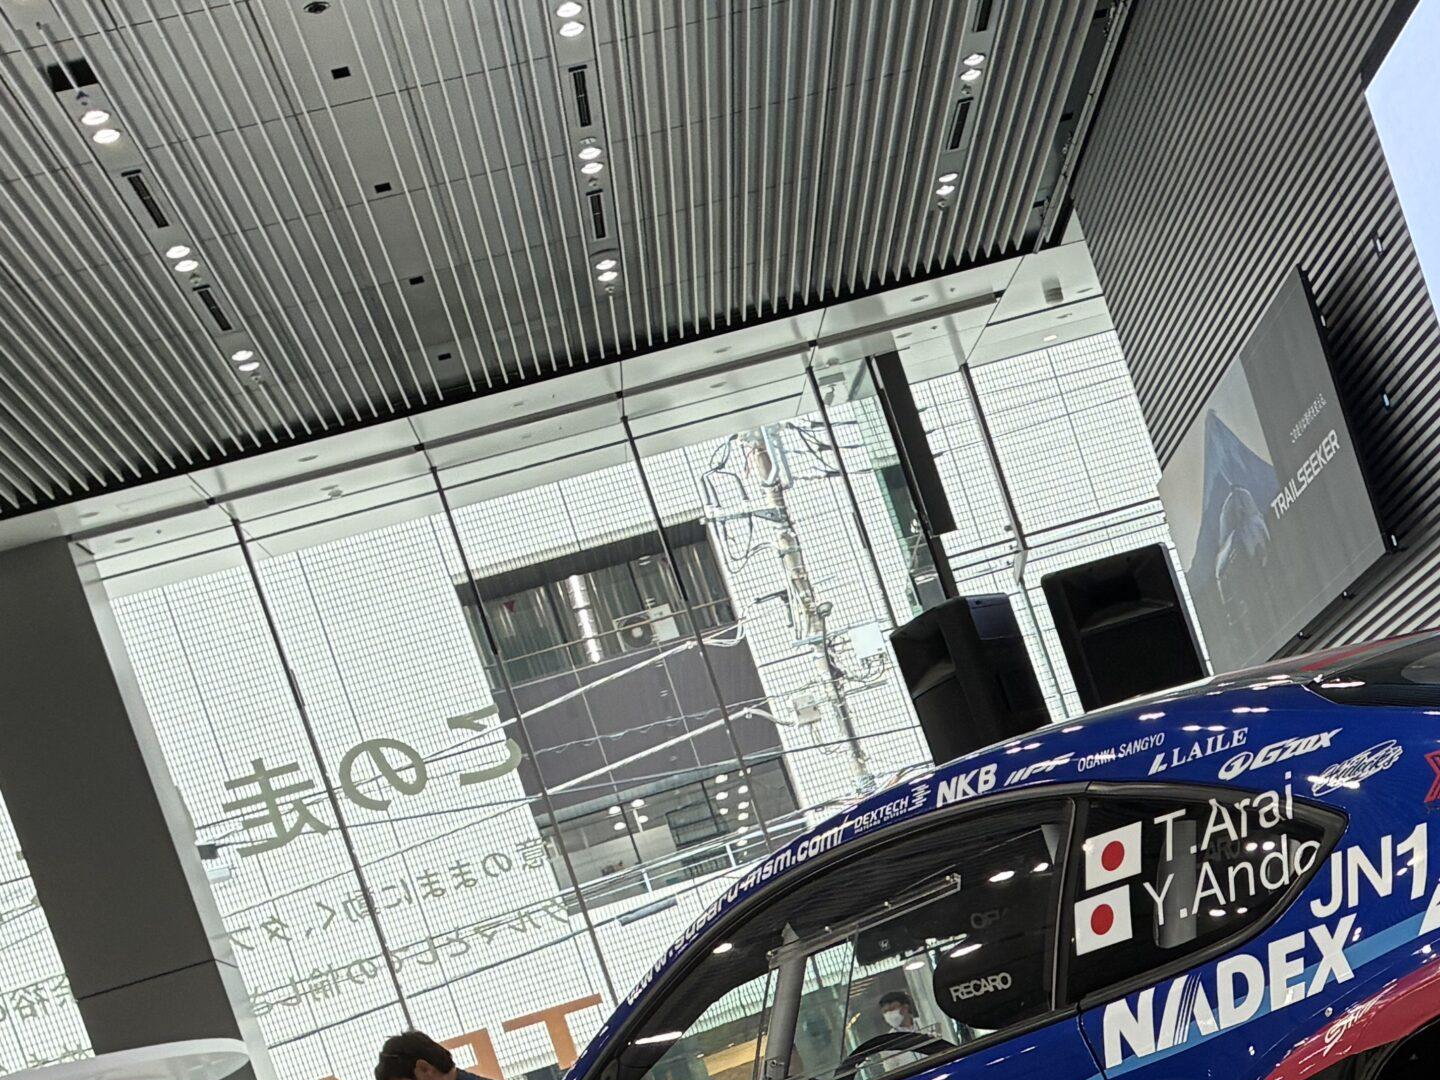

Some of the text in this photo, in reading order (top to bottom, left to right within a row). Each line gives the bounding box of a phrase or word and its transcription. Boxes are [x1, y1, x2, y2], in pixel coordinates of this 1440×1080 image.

[1270, 429, 1340, 519] TRAILSEEKER
[1118, 732, 1166, 759] SANGYO
[1172, 727, 1249, 768] LAILE
[936, 763, 998, 808] NKB
[854, 796, 910, 827] DEXTECH
[1309, 822, 1428, 919] JN1
[950, 972, 1012, 1003] RECARO
[1104, 916, 1354, 1069] NADEX
